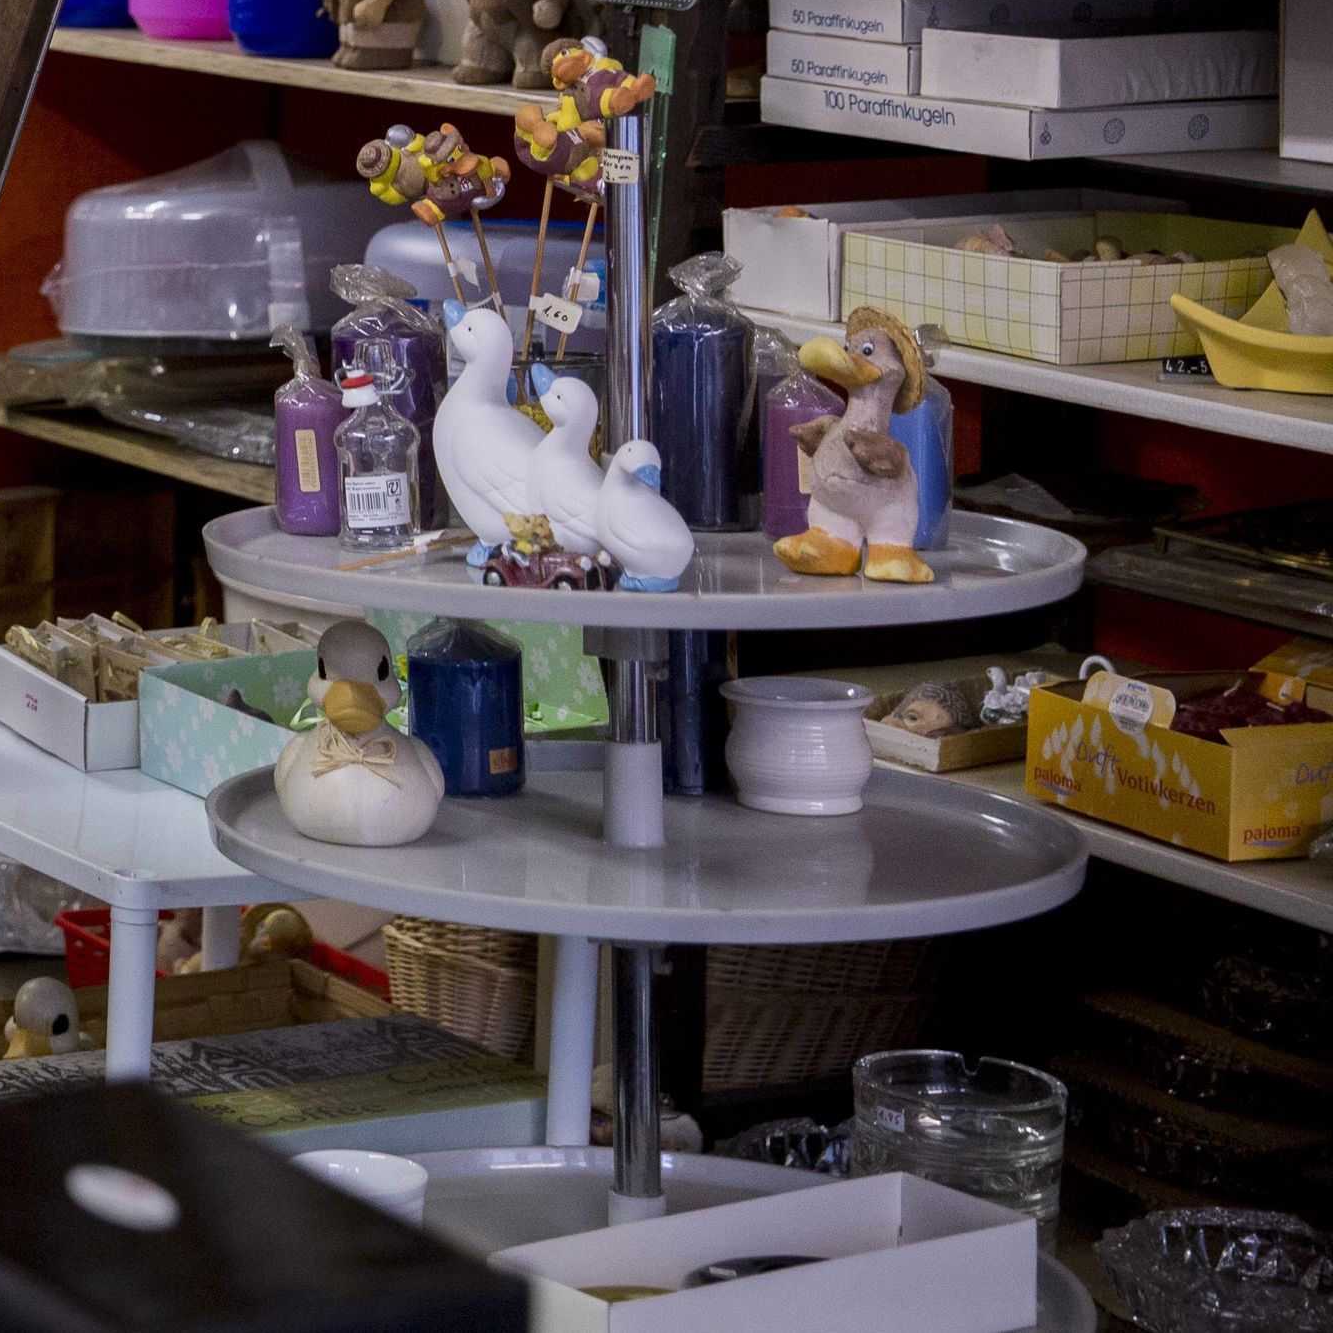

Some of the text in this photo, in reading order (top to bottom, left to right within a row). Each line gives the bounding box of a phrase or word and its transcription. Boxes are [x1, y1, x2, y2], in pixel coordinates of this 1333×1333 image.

[791, 9, 884, 34] 50 Paraffinkugeln
[790, 58, 889, 86] 50 Paraffinkugeln
[823, 89, 956, 127] 100 Paraffinkugeln
[1033, 766, 1082, 793] pajoma
[1117, 767, 1216, 816] Votivkerzen
[1242, 824, 1302, 844] pajoma
